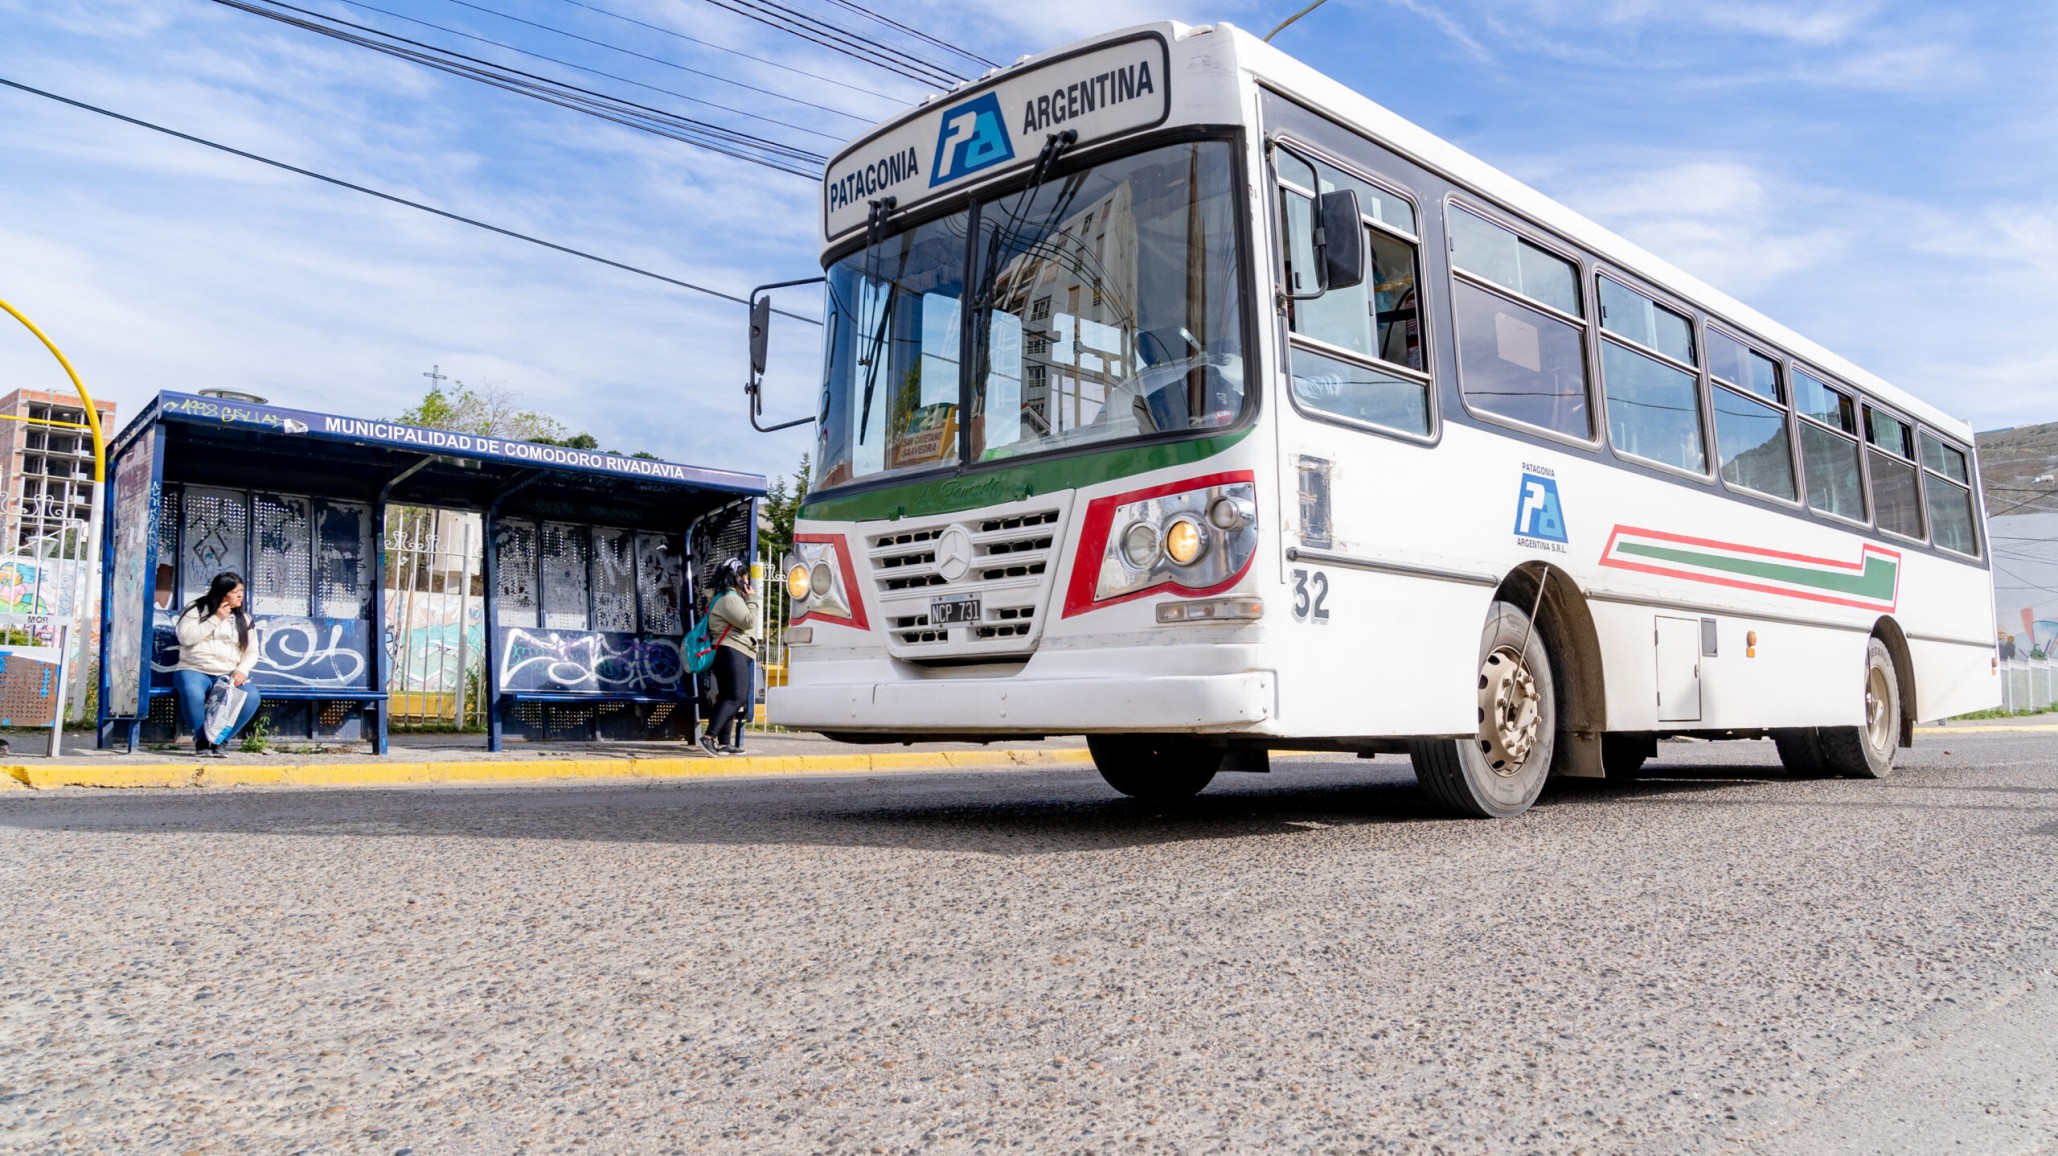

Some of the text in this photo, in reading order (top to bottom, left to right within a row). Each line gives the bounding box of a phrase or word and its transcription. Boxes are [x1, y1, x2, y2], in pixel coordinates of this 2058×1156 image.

[830, 146, 919, 213] PATAGONIA
[1023, 61, 1154, 135] ARGENTINA
[915, 431, 943, 445] CAYETANO
[325, 416, 471, 450] MUNICIPALIDAD
[477, 438, 500, 454] DE
[504, 442, 602, 469] COMODORO
[606, 457, 685, 480] RIVADAVIA
[901, 442, 937, 458] SAAVEDRA
[1521, 461, 1556, 478] PATAGONIA
[1516, 538, 1567, 554] ARGENTINA S.R.L.
[1291, 569, 1330, 621] 32
[932, 601, 980, 623] NCP 731
